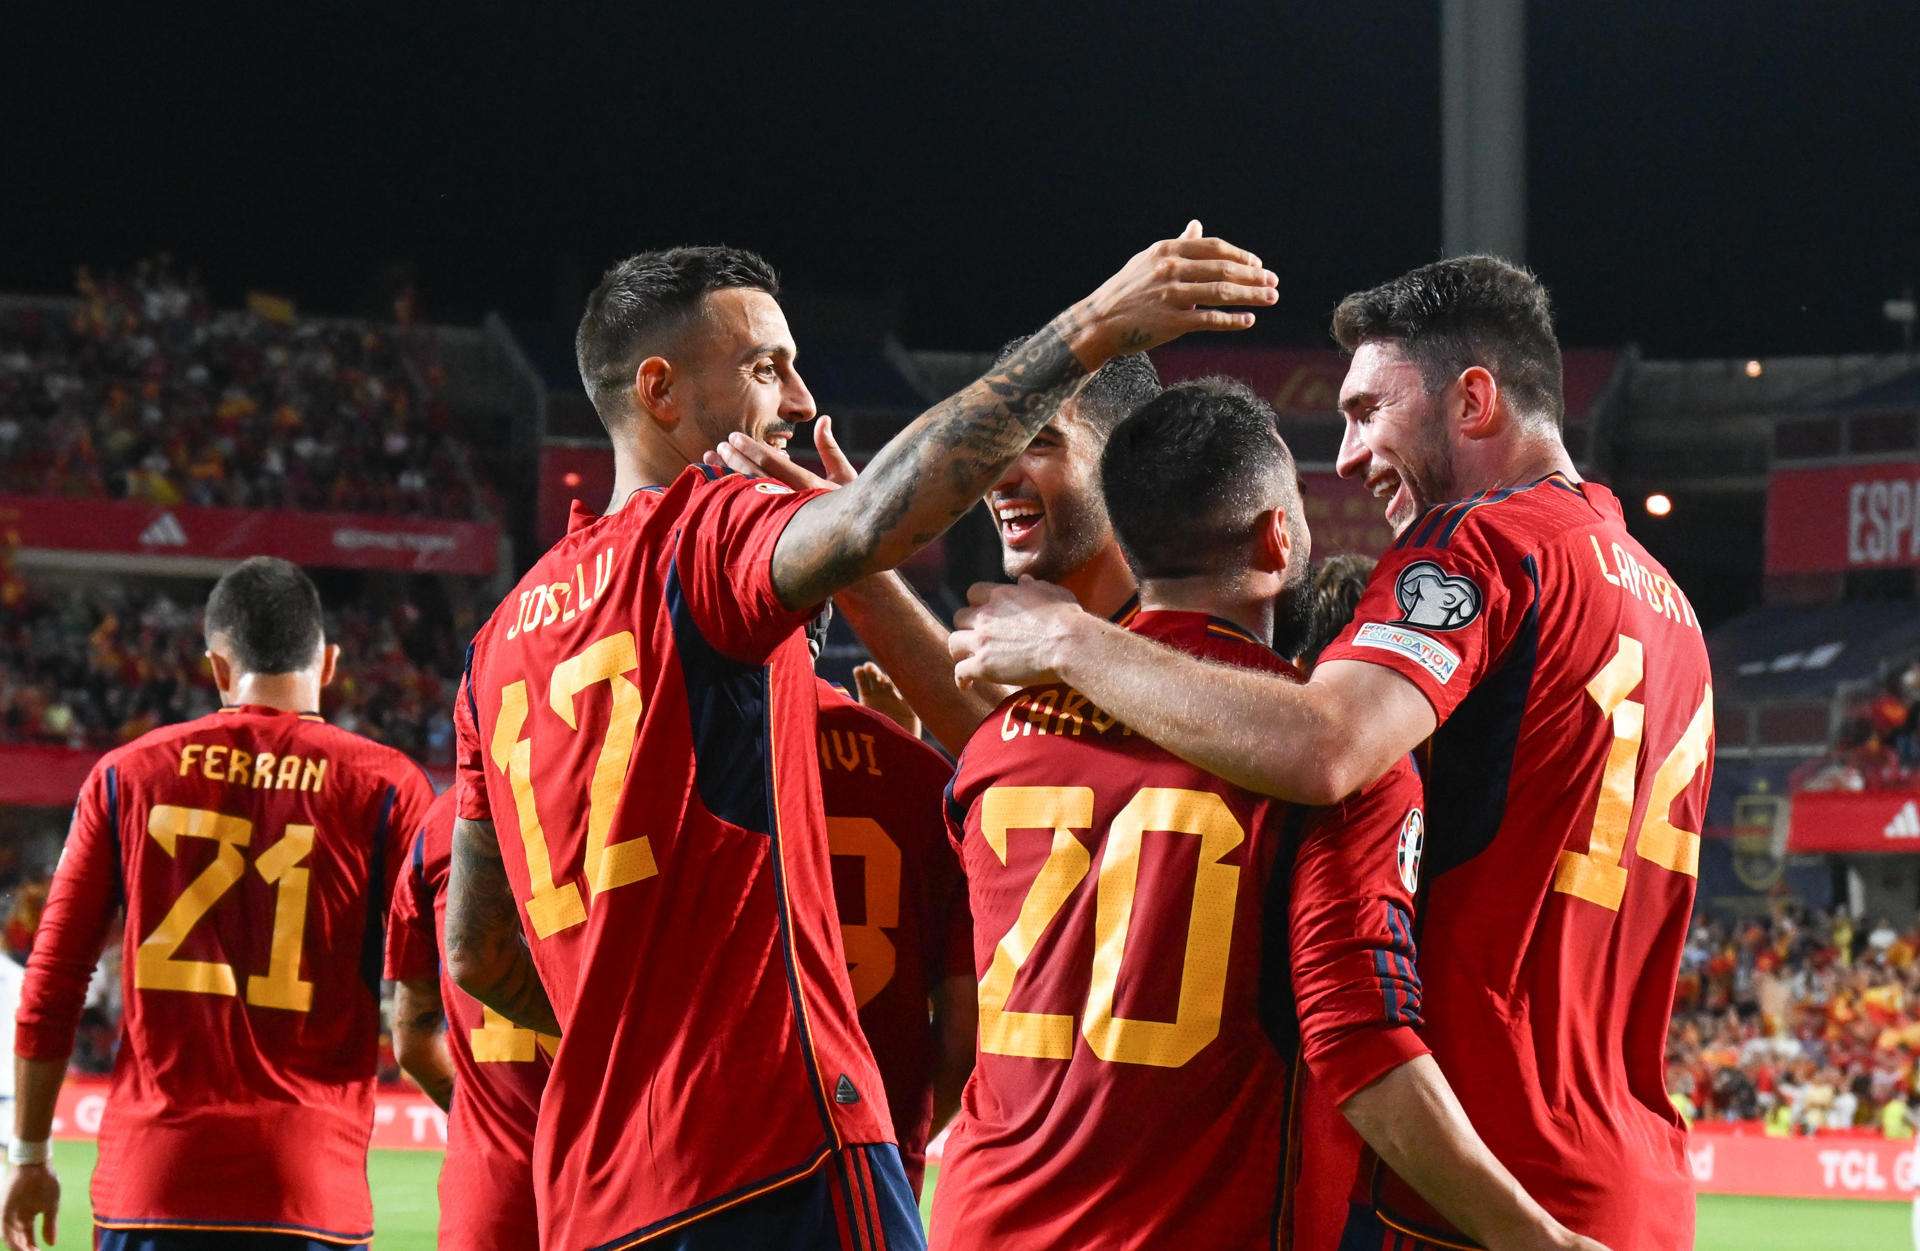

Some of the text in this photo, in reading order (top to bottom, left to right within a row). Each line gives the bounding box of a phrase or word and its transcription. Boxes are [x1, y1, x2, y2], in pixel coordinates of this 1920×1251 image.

[1589, 534, 1703, 635] LAPORT
[1360, 629, 1453, 674] FOUNDATION
[179, 743, 328, 794] FERRAN
[135, 804, 316, 1012] 21
[977, 786, 1246, 1069] 20
[1818, 1150, 1887, 1191] TCL
